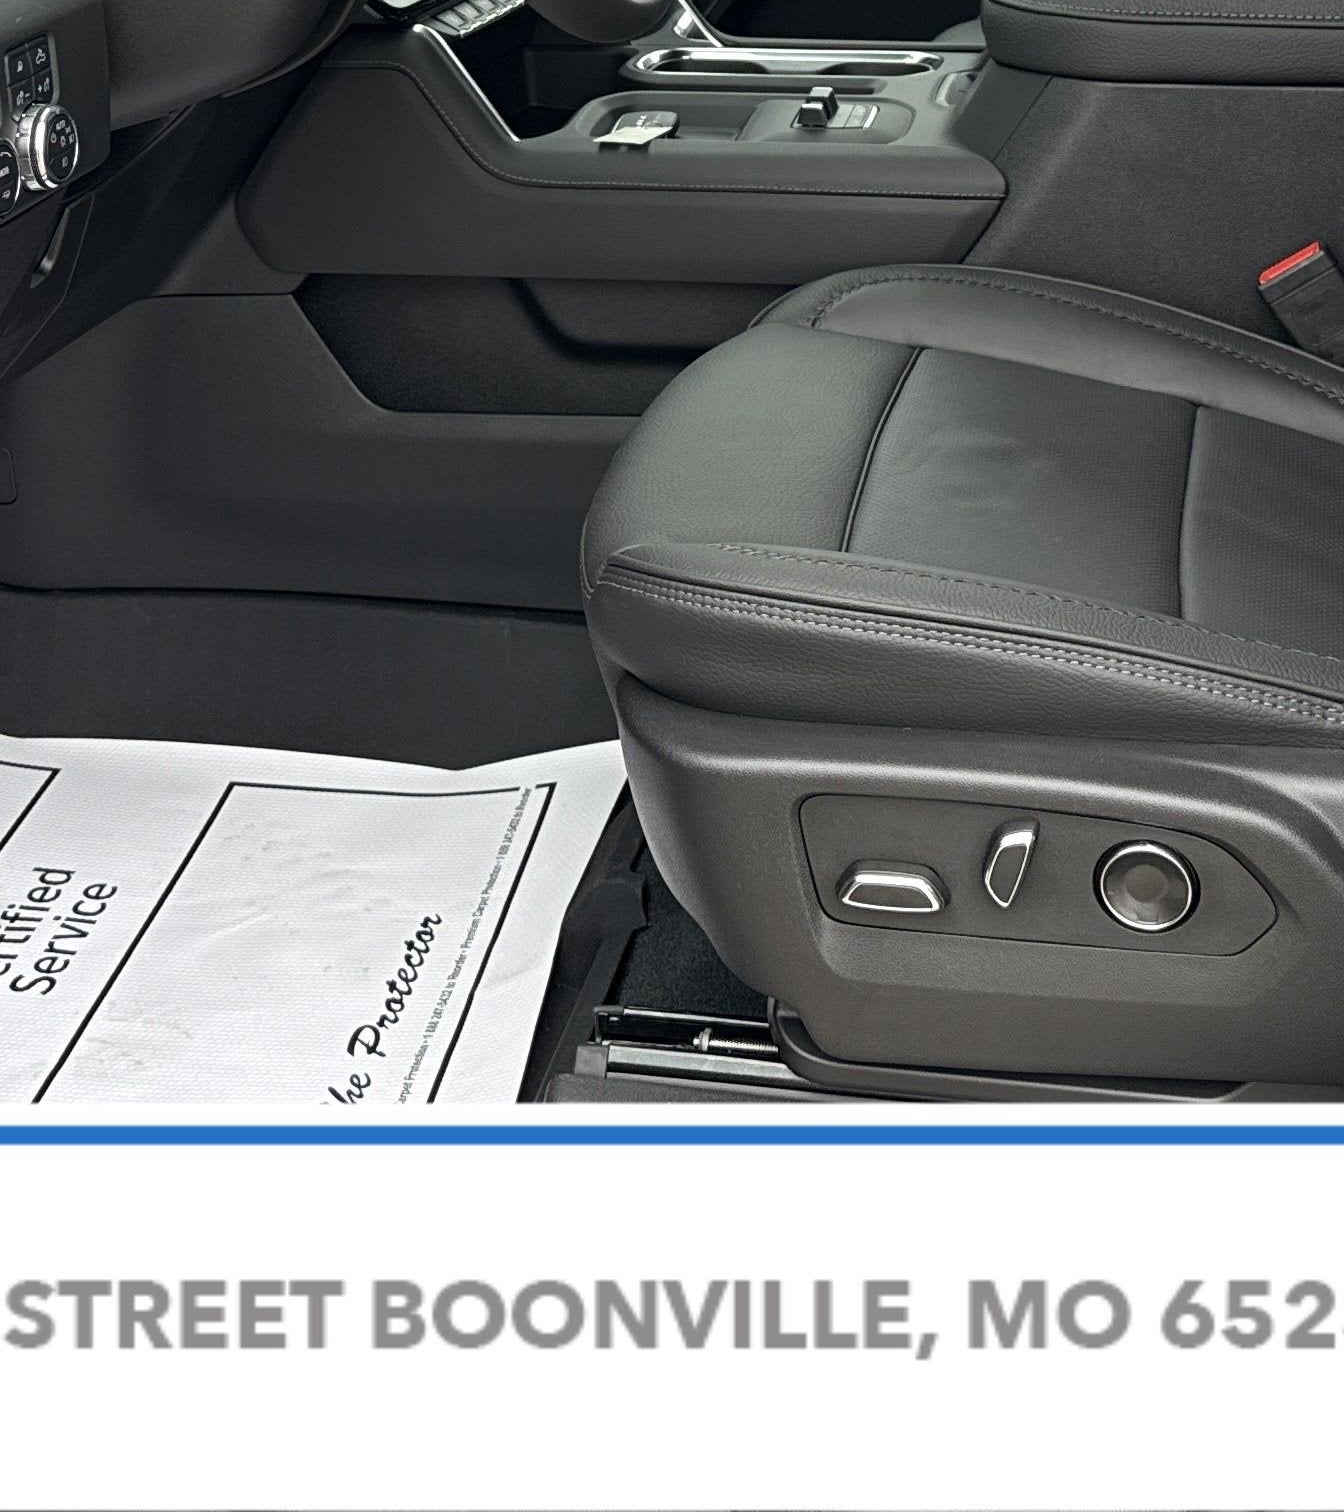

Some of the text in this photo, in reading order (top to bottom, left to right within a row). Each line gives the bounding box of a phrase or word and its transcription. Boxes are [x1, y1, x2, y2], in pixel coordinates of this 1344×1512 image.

[9, 883, 118, 996] Service
[327, 913, 443, 1104] he Protector
[399, 1083, 413, 1104] arpet
